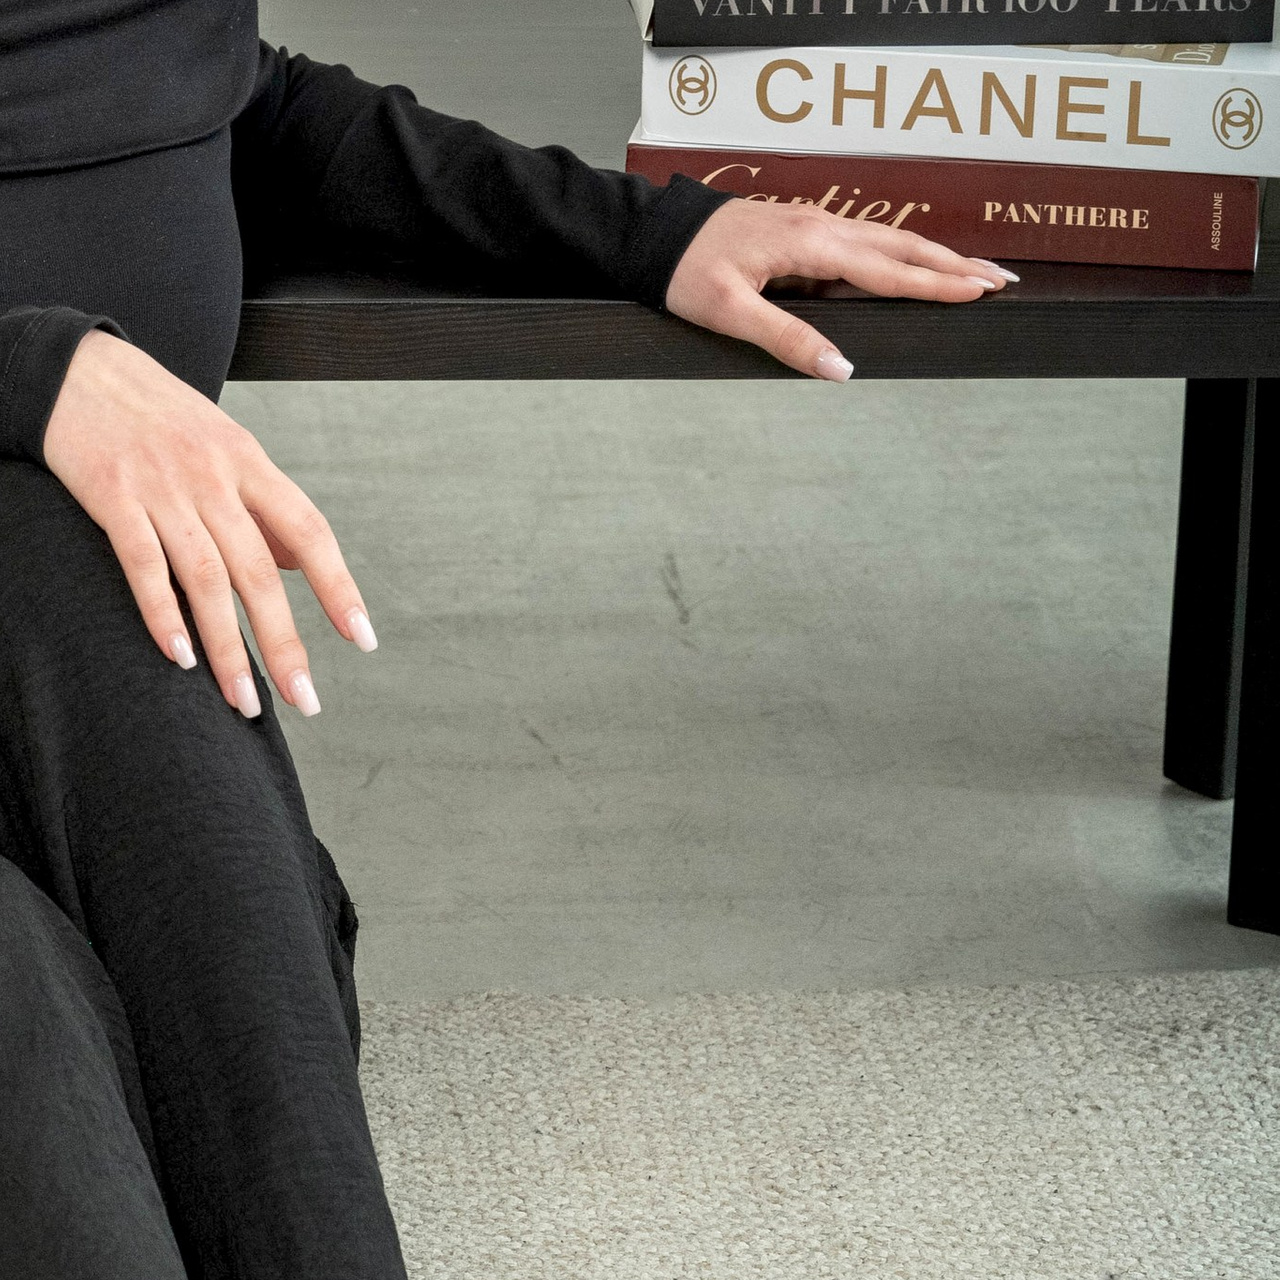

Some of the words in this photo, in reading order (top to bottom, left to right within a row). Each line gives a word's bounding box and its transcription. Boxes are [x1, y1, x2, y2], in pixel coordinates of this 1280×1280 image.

[1172, 42, 1217, 64] Dio
[755, 57, 1172, 148] CHANEL
[984, 201, 1150, 230] PANTHERE
[1210, 192, 1224, 252] ASSOULINE
